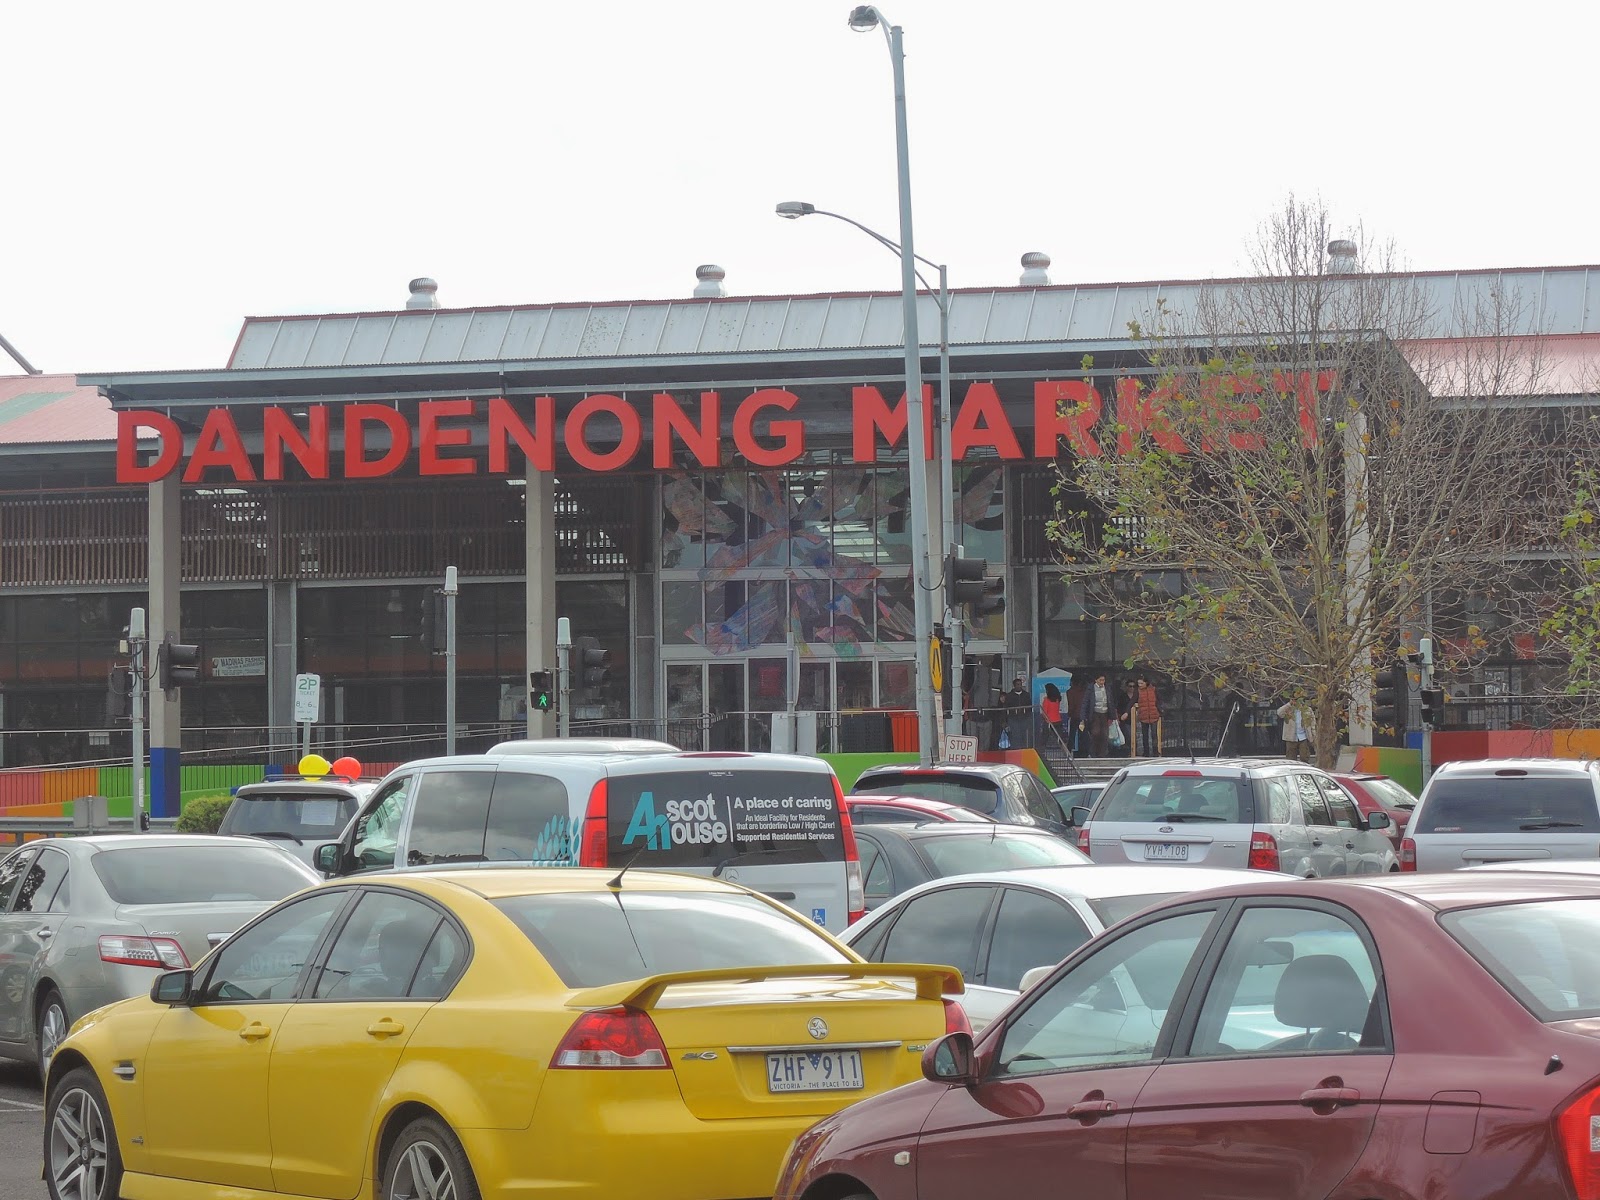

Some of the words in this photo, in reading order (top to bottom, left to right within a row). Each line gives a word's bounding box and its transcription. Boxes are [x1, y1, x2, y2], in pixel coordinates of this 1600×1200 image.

[116, 388, 805, 484] DANDENONG
[852, 370, 1341, 464] MARKET
[298, 677, 318, 690] 2P
[950, 739, 973, 751] STOP
[948, 753, 973, 763] HERE
[734, 796, 744, 809] A
[746, 796, 779, 811] place
[781, 796, 793, 808] of
[796, 796, 832, 811] caring
[745, 814, 754, 822] An
[754, 813, 768, 822] Ideal
[769, 813, 789, 823] Facility
[789, 813, 798, 821] for
[798, 813, 826, 822] Residents
[736, 822, 748, 830] that
[759, 821, 788, 830] borderline
[788, 821, 801, 829] Low
[804, 821, 818, 831] High
[736, 833, 770, 842] Supported
[771, 832, 807, 841] Residential
[808, 832, 835, 840] Services
[1146, 845, 1163, 856] YVH
[1171, 845, 1187, 856] 108
[770, 1056, 806, 1082] ZHF
[822, 1054, 858, 1080] 911
